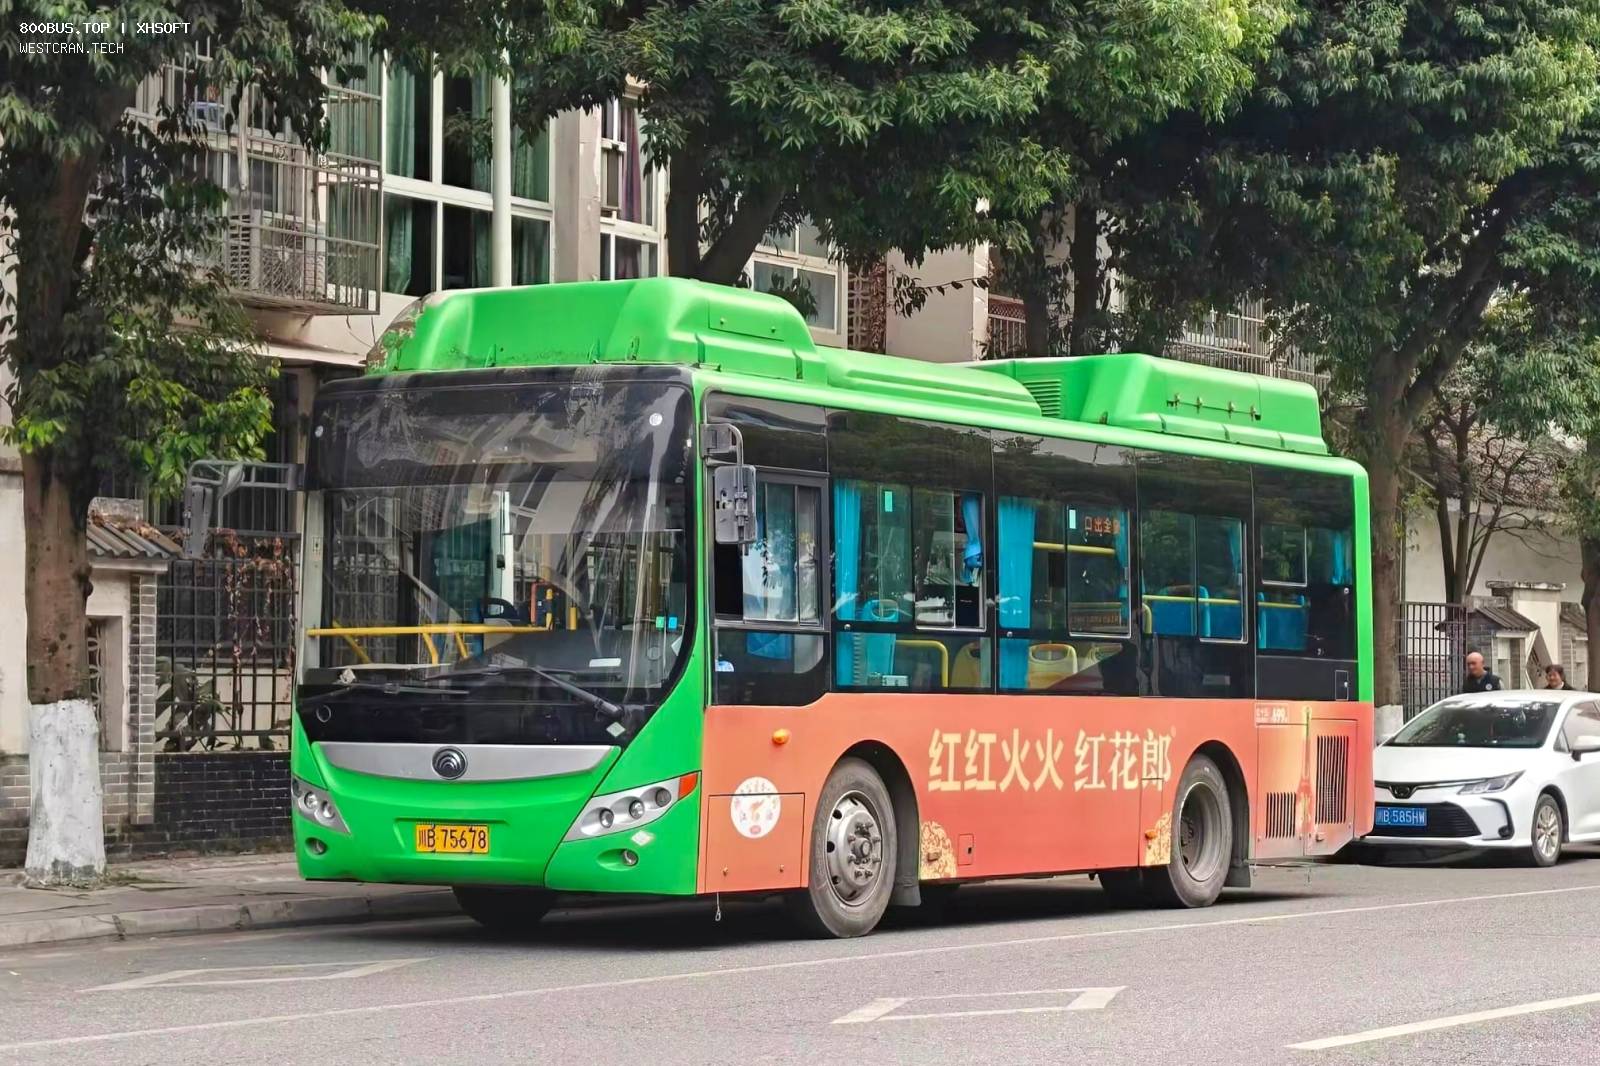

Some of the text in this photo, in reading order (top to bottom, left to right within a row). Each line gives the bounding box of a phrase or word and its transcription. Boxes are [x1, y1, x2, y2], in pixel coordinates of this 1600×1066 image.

[927, 727, 1172, 792] 红红火火 红花郎
